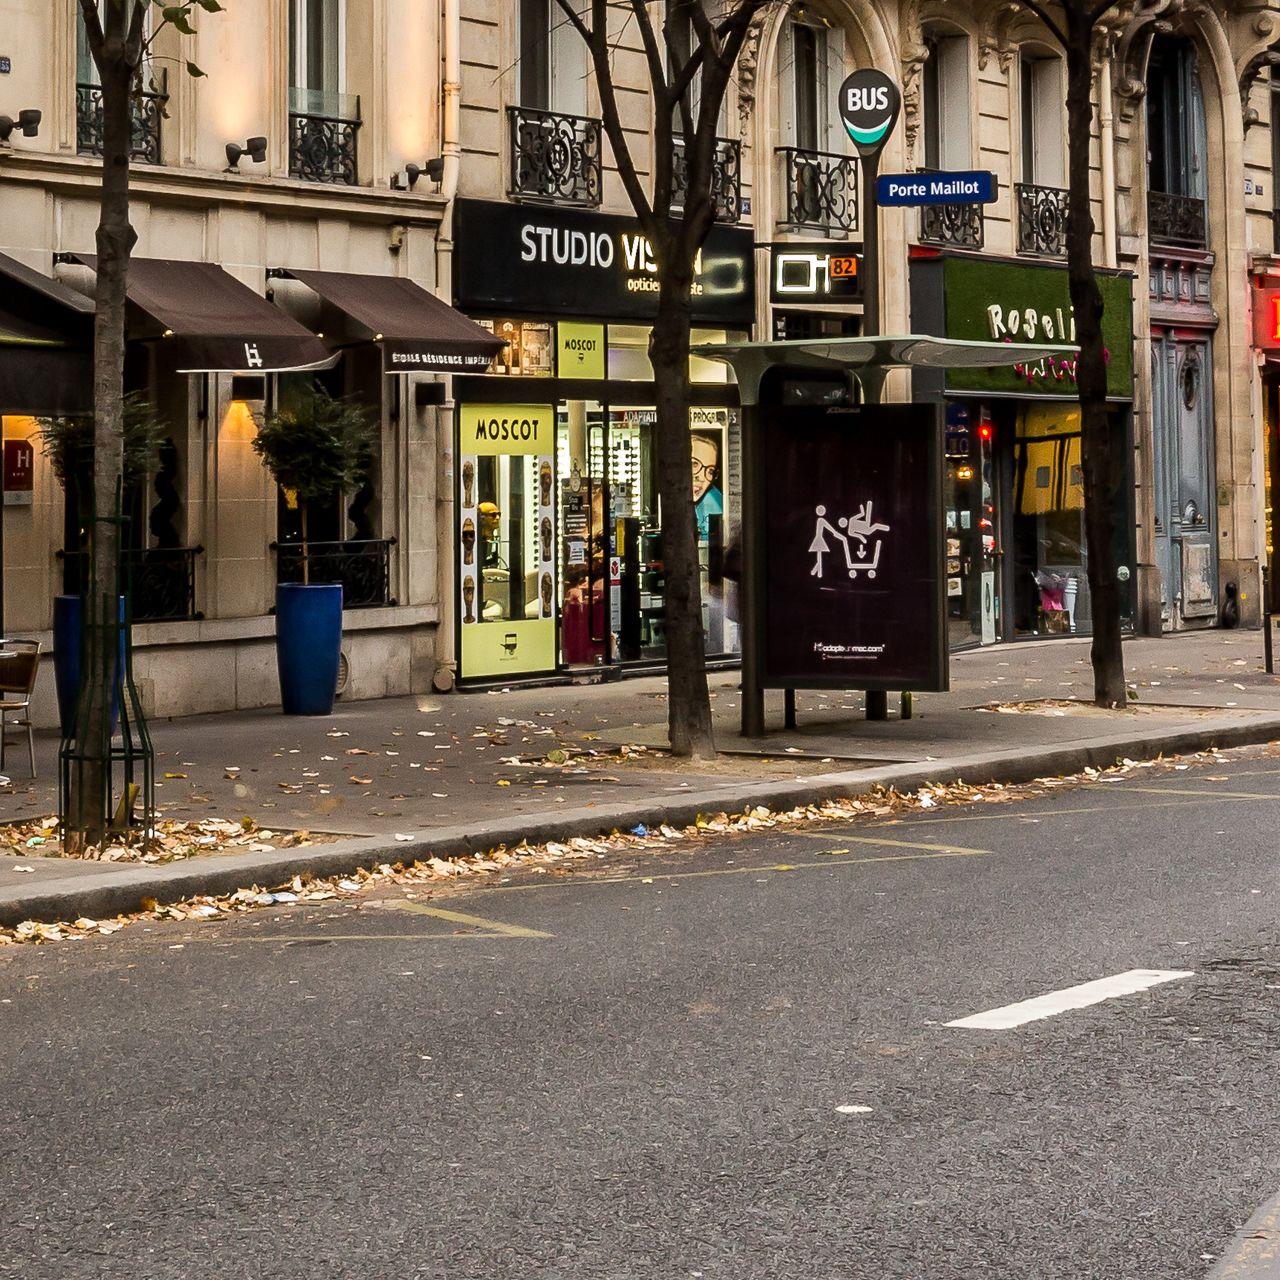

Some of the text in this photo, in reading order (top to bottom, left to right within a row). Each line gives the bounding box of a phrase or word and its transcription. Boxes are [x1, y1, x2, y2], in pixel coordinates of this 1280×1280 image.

[847, 86, 889, 111] BUS
[889, 180, 979, 196] Porte Maillot
[521, 224, 614, 268] STUDIO
[833, 259, 853, 274] 82
[564, 339, 597, 351] MOSCOT
[421, 351, 463, 365] RÉSIDENCE
[475, 418, 540, 441] MOSCOT
